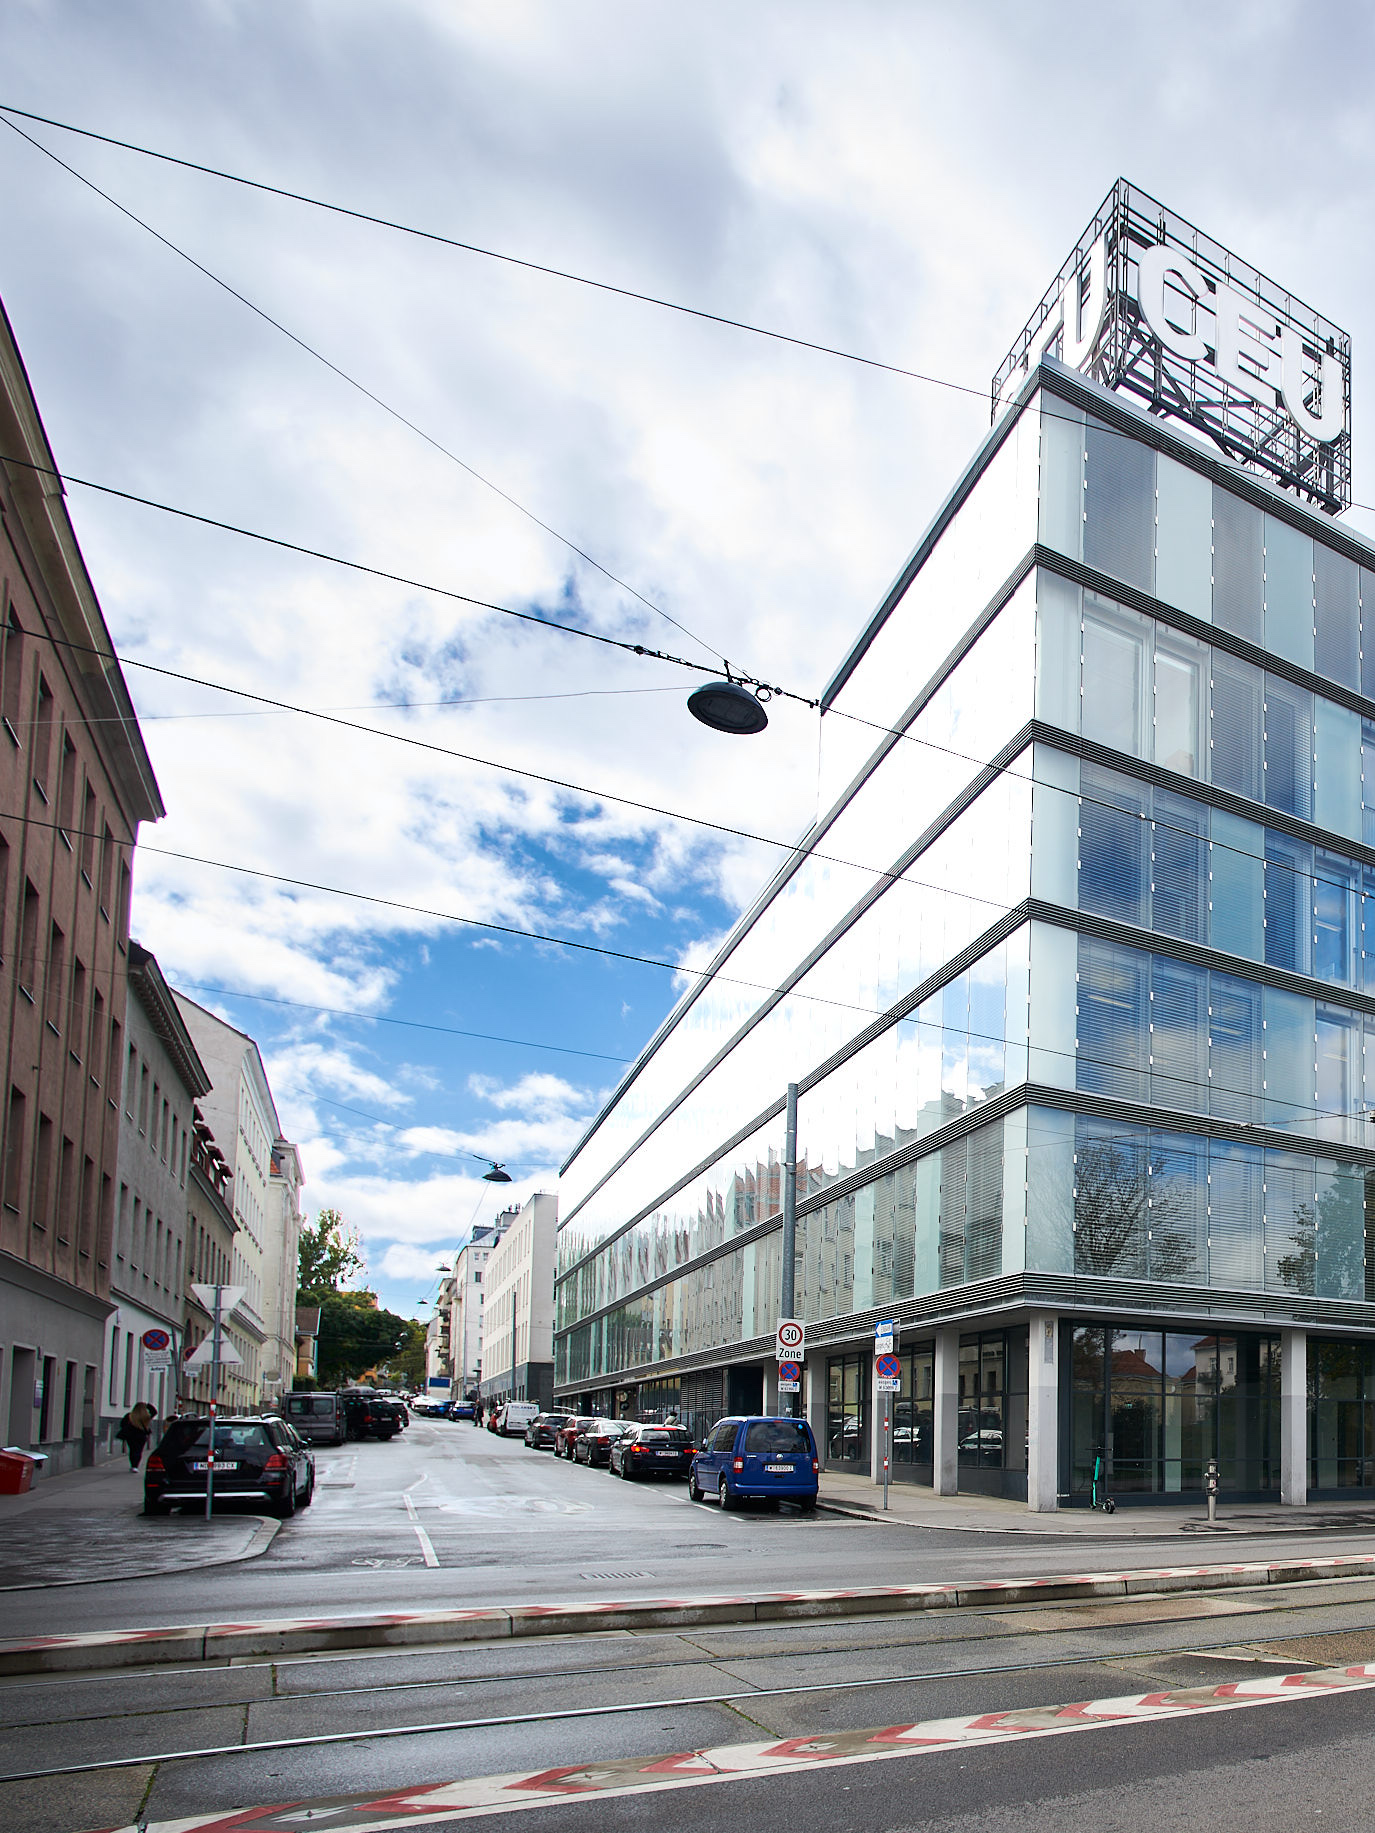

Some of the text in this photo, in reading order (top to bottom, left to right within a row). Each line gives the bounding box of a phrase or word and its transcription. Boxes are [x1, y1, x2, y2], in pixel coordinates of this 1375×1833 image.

[1138, 243, 1344, 443] CEU
[785, 1329, 797, 1340] 30
[779, 1347, 801, 1359] Zone
